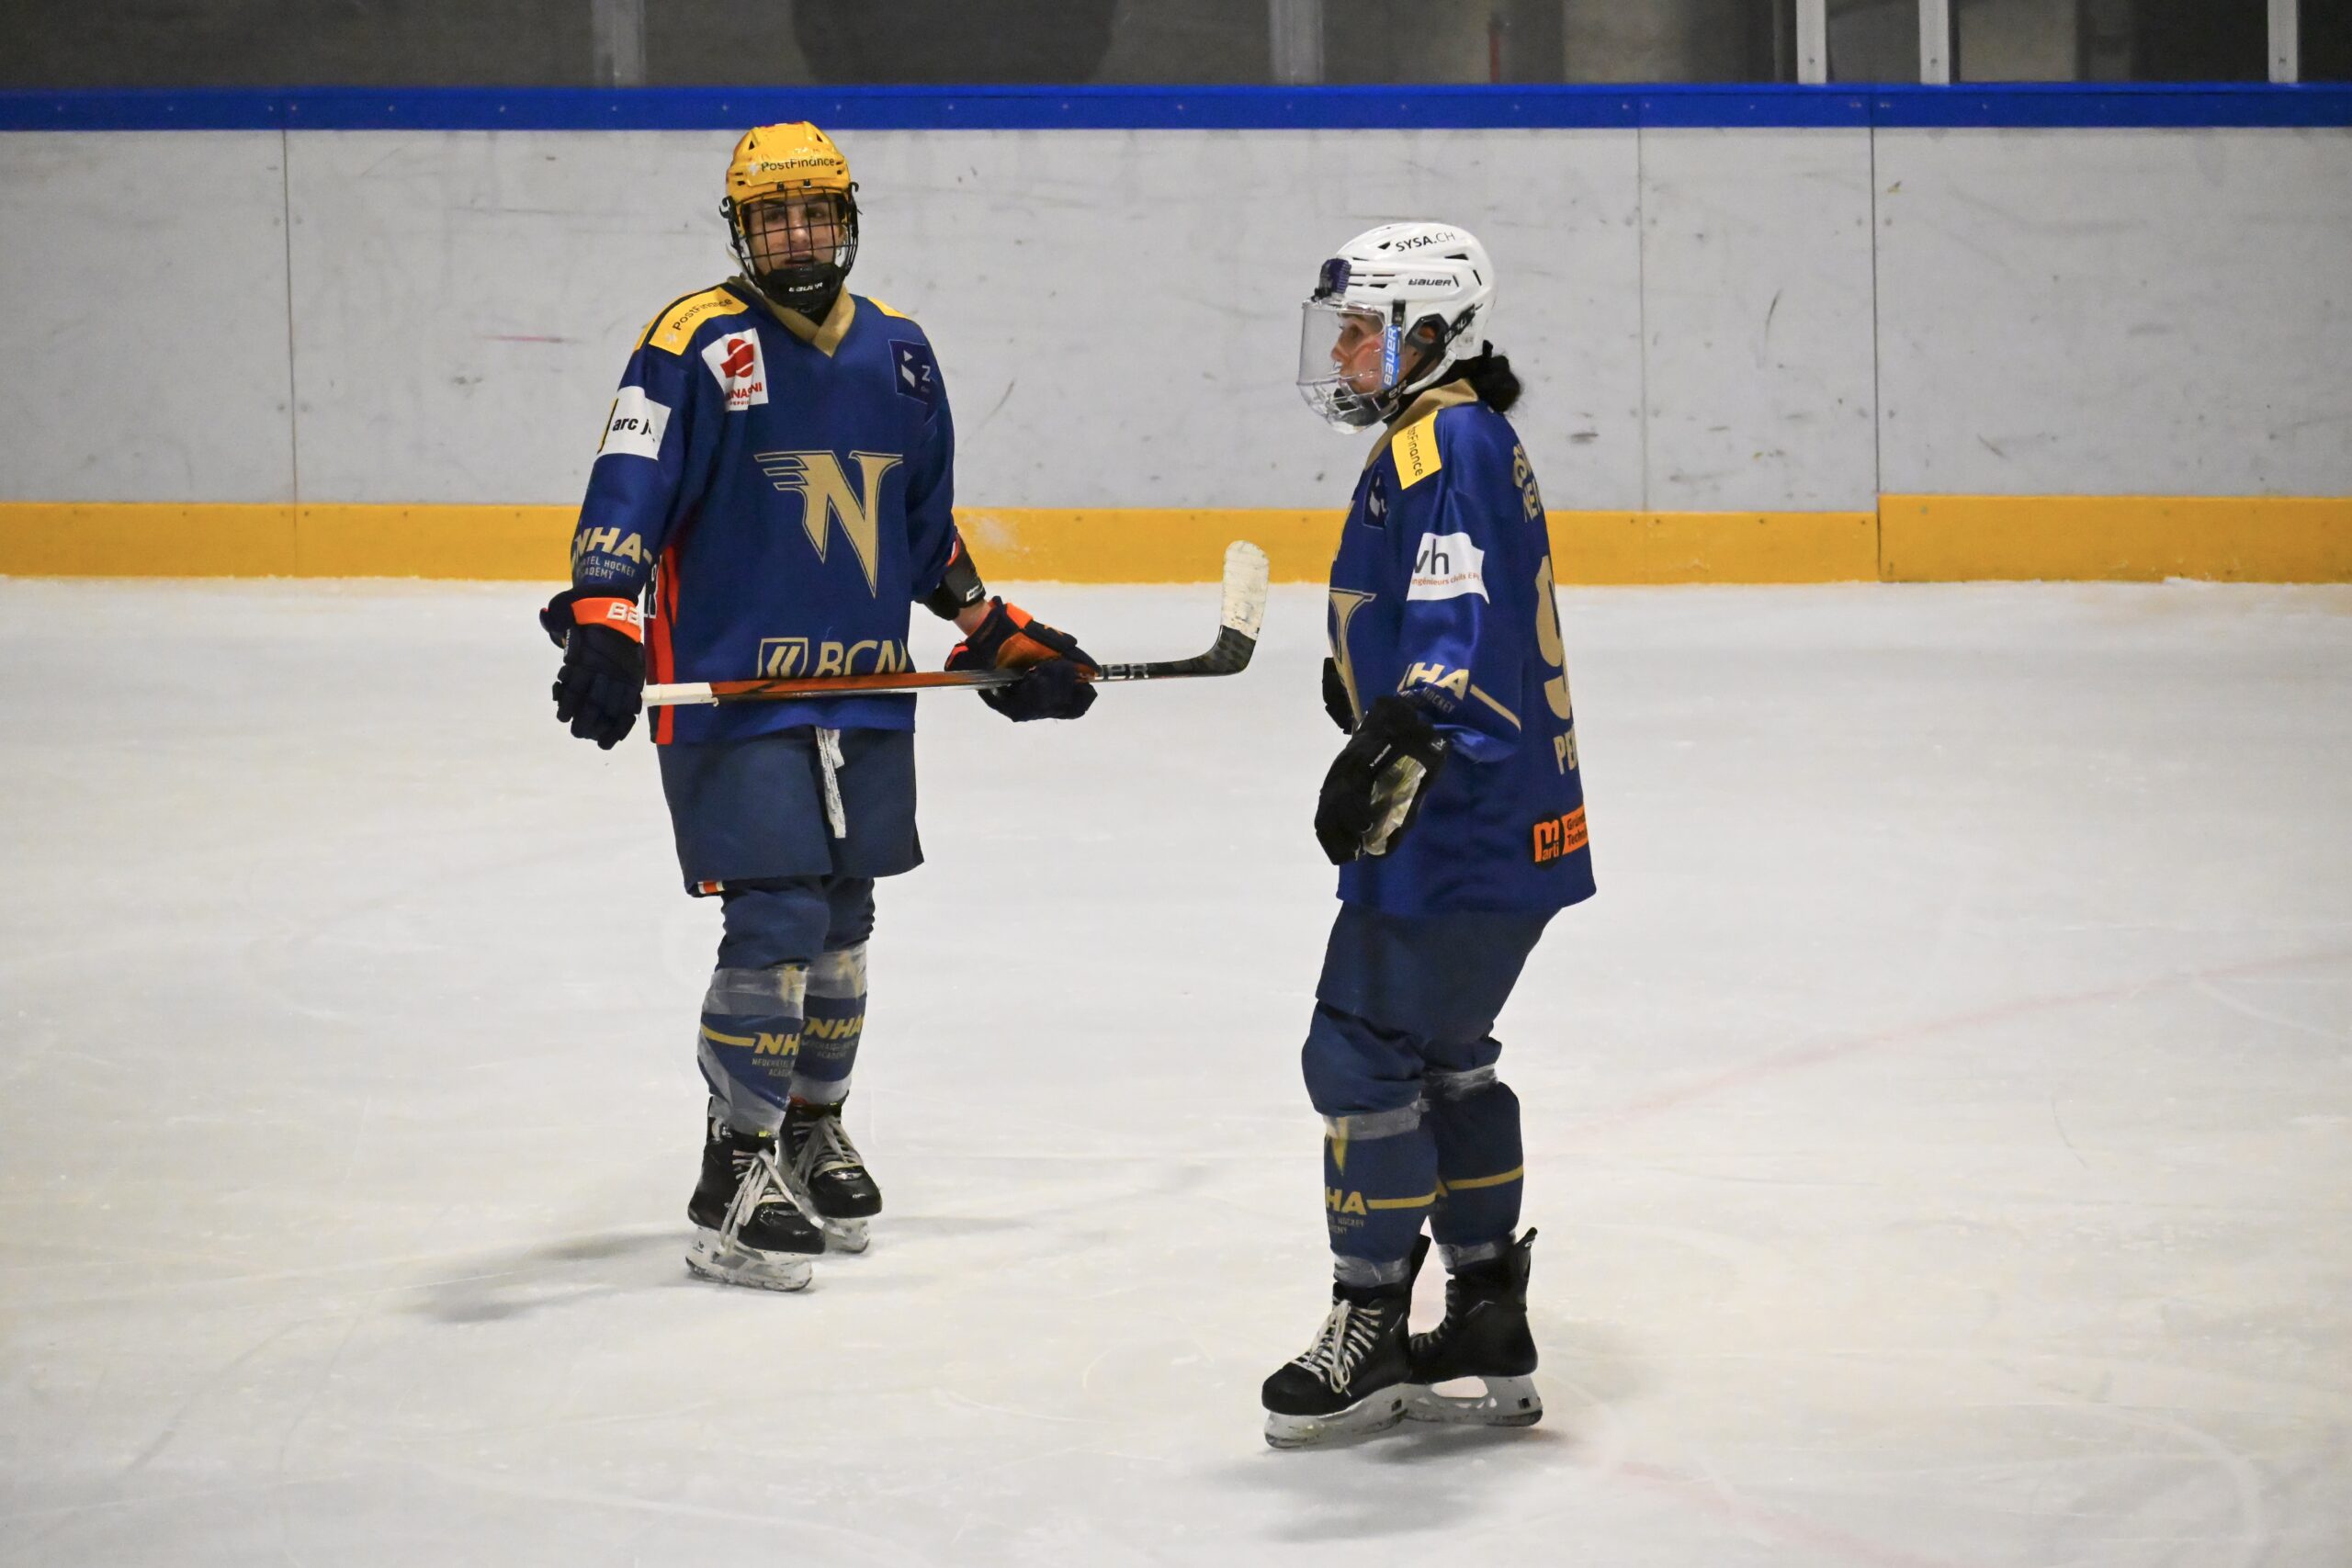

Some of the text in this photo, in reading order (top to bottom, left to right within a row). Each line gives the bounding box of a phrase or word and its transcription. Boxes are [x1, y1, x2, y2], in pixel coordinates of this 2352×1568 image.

[761, 156, 835, 172] PostFinance
[1396, 231, 1455, 252] SYSA.CH
[612, 418, 639, 432] arc
[605, 559, 636, 578] HOCKEY
